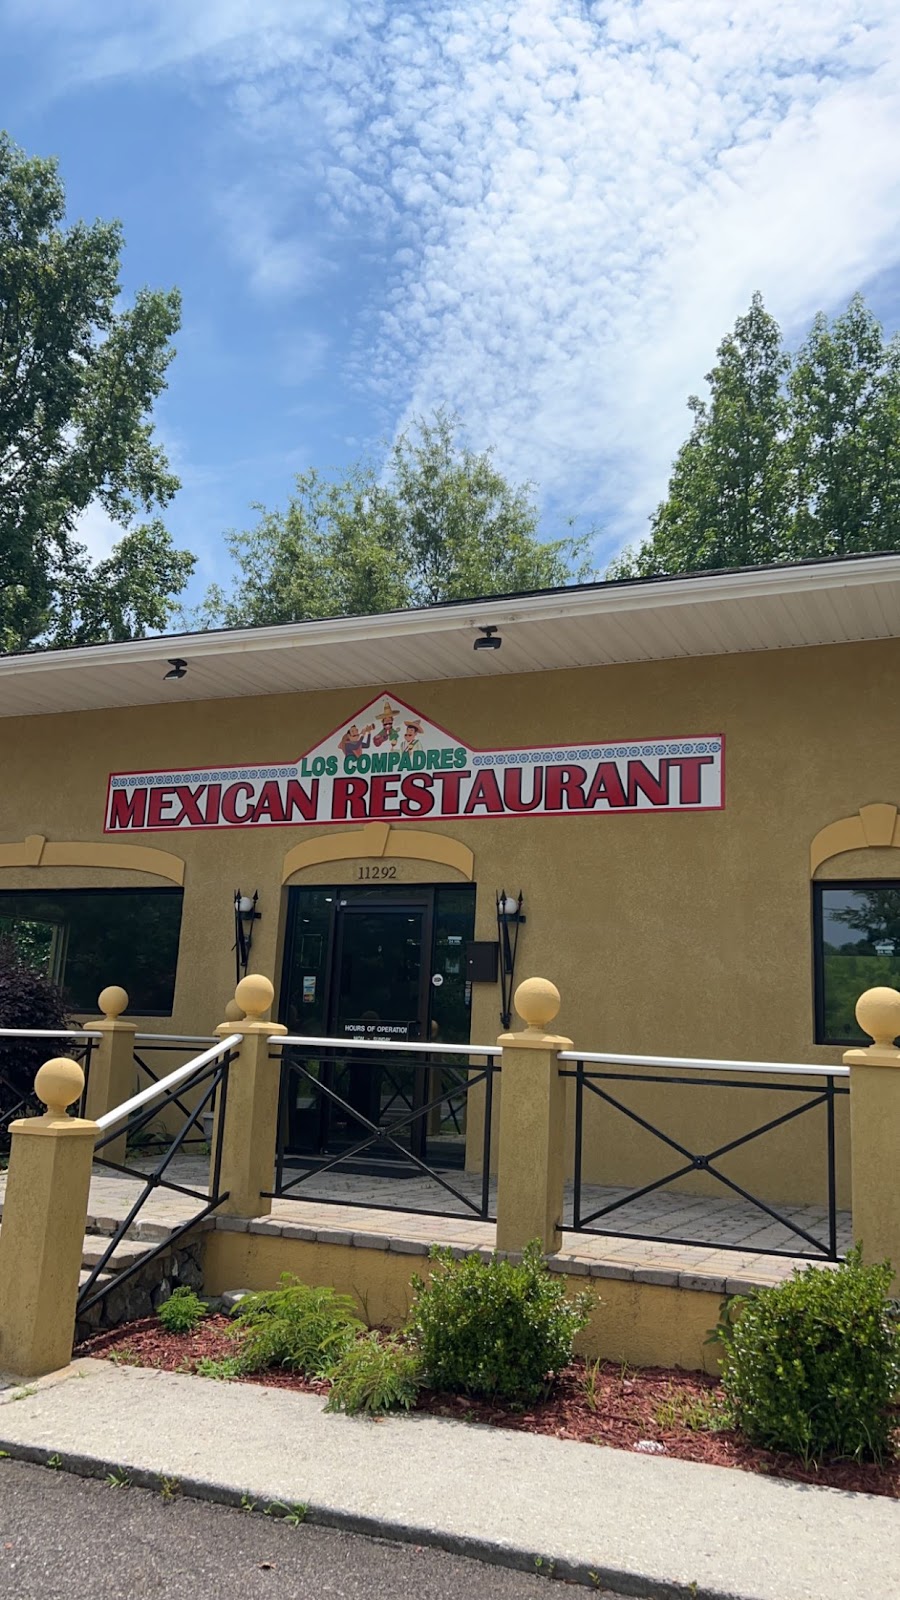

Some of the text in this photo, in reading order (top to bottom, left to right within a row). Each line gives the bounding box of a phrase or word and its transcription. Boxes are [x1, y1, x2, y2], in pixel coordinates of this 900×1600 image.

[301, 747, 467, 777] LOS COMPADRES
[109, 755, 714, 829] MEXICAN RESTAURANT
[358, 866, 397, 880] 11292
[344, 1024, 366, 1032] HOURS
[366, 1025, 376, 1033] OF
